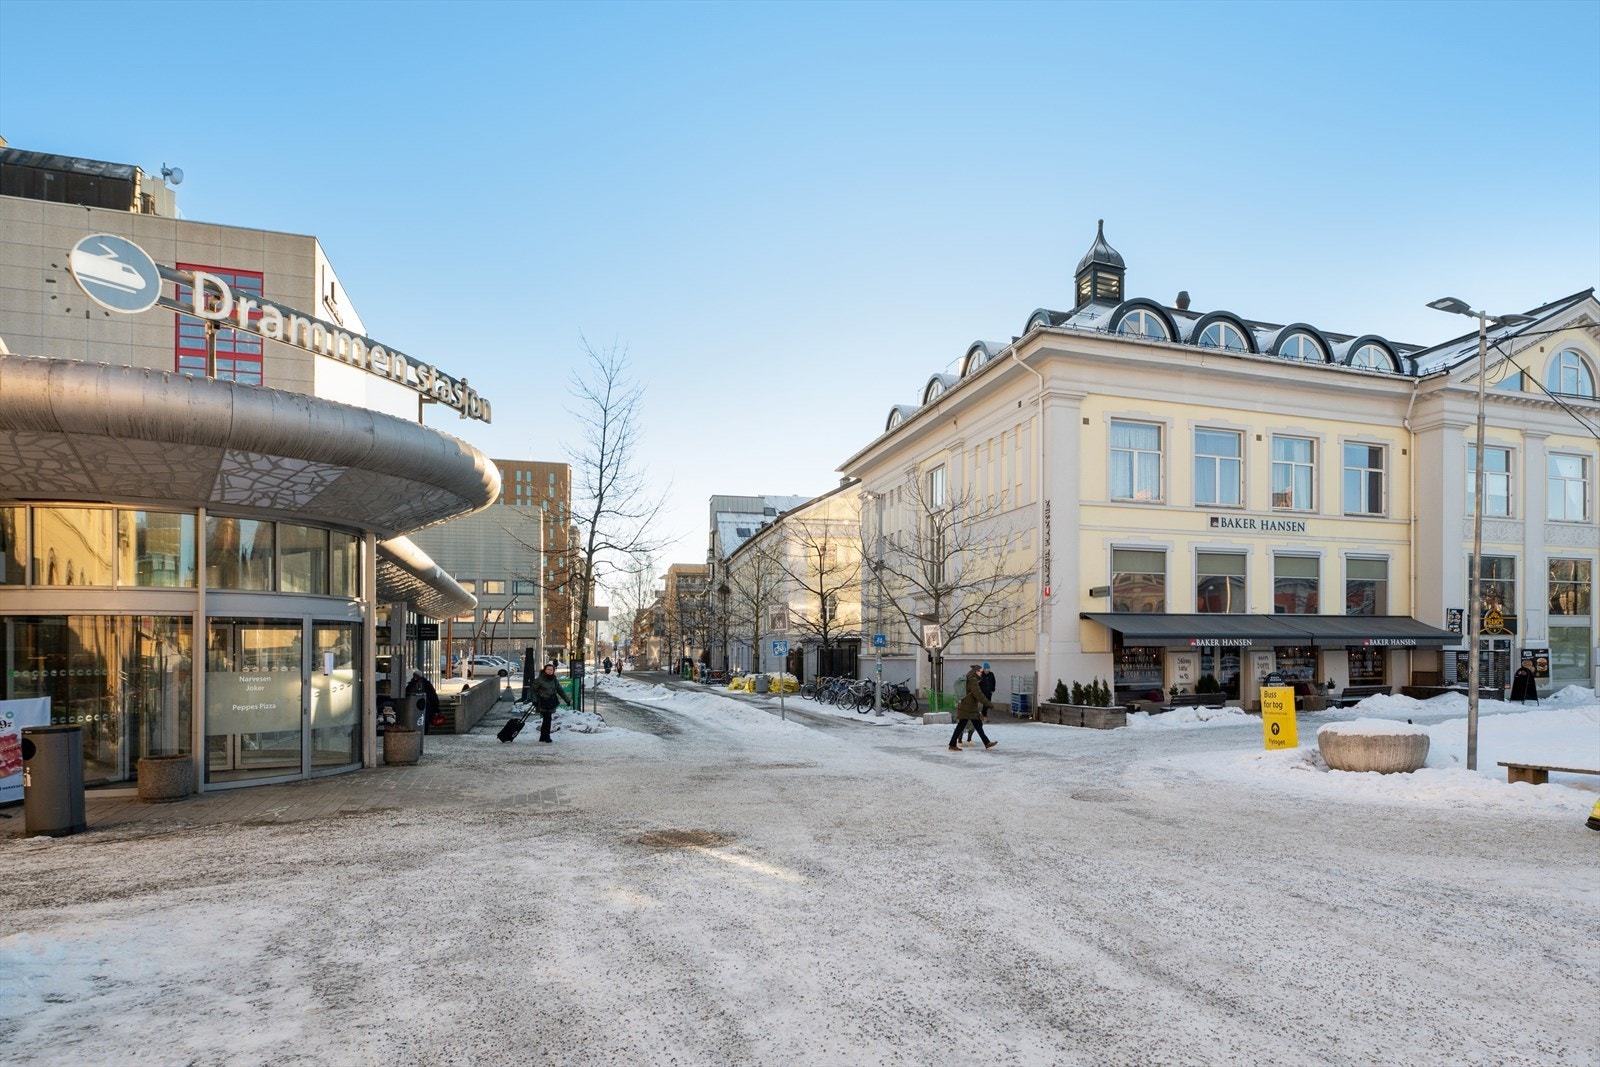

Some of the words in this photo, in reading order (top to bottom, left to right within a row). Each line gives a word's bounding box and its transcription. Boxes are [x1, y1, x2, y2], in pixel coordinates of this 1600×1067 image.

[192, 271, 408, 385] Drammen
[413, 363, 492, 424] stasjon
[1221, 517, 1257, 530] BAKER
[1260, 519, 1306, 532] HANSEN
[1264, 690, 1277, 698] Buss
[232, 704, 258, 712] Peppes
[259, 702, 277, 710] Pizza
[1263, 700, 1272, 708] for
[1273, 701, 1283, 710] tog
